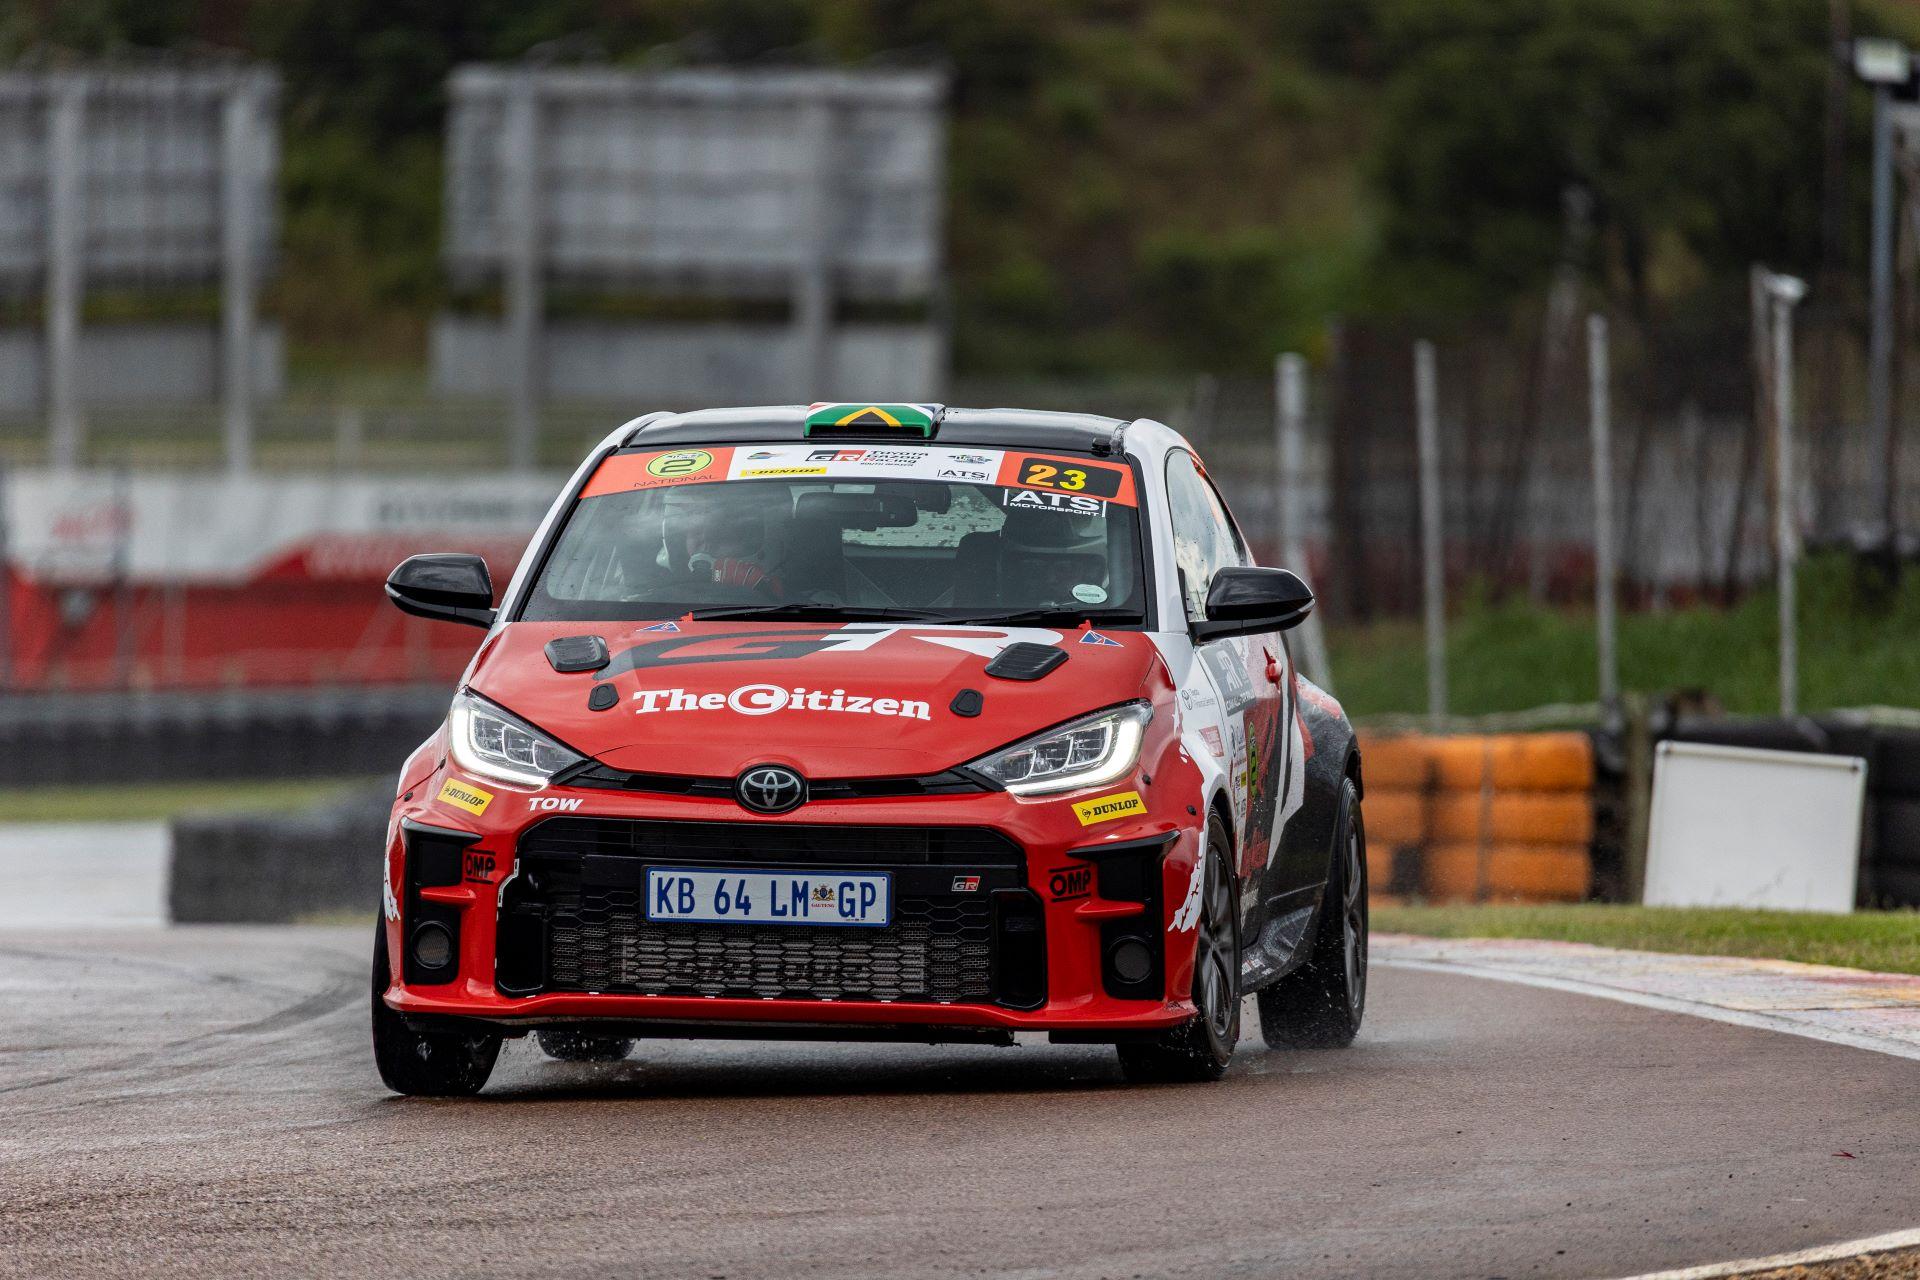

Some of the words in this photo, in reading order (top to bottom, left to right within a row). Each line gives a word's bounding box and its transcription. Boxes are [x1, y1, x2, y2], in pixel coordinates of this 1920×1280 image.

[805, 452, 865, 461] GR
[660, 459, 697, 473] 2
[633, 475, 718, 487] NATIONAL
[941, 470, 986, 479] ATS
[1026, 464, 1087, 490] 23
[1010, 490, 1100, 511] ATS
[1009, 502, 1100, 517] MOTORSPORT
[449, 788, 485, 807] DUNLOP
[528, 797, 584, 812] TOW
[1093, 799, 1140, 816] DUNLOP
[465, 853, 495, 878] OMP
[953, 881, 978, 890] GR
[1049, 869, 1092, 896] OMP
[656, 876, 696, 914] KB
[713, 878, 752, 916] 64
[770, 879, 810, 917] LM
[838, 881, 877, 919] GP
